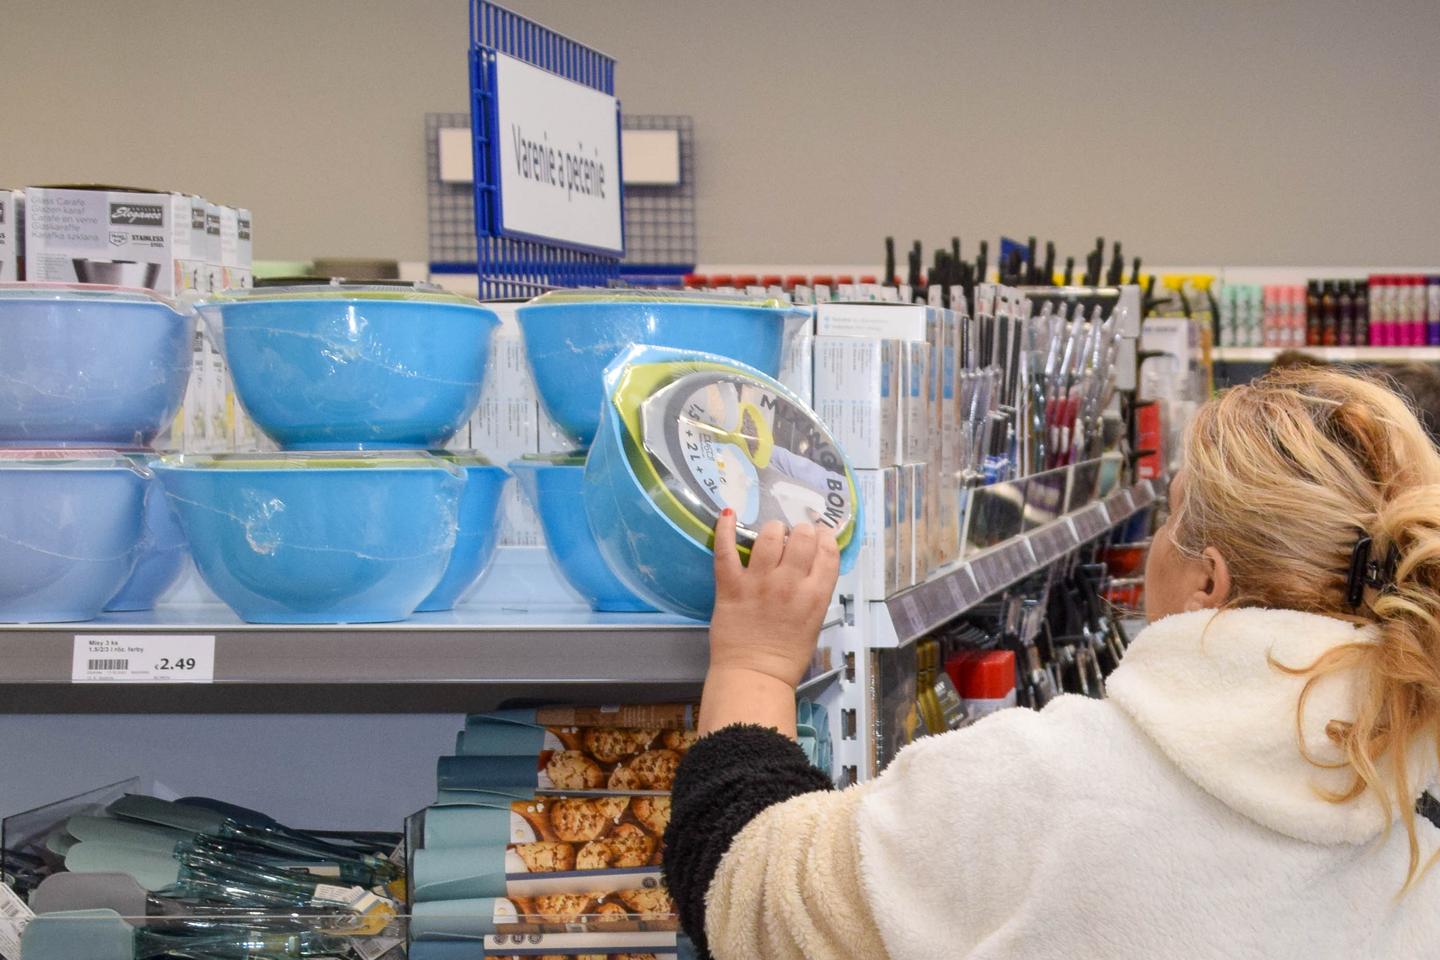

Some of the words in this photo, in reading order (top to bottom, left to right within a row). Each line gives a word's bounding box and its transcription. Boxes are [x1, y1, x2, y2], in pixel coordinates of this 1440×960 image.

[511, 122, 556, 187] Varenie
[558, 149, 565, 188] a
[566, 140, 605, 202] pečenie
[111, 206, 162, 224] Elegance
[131, 235, 165, 243] STAINLESS
[815, 477, 844, 530] BOWL
